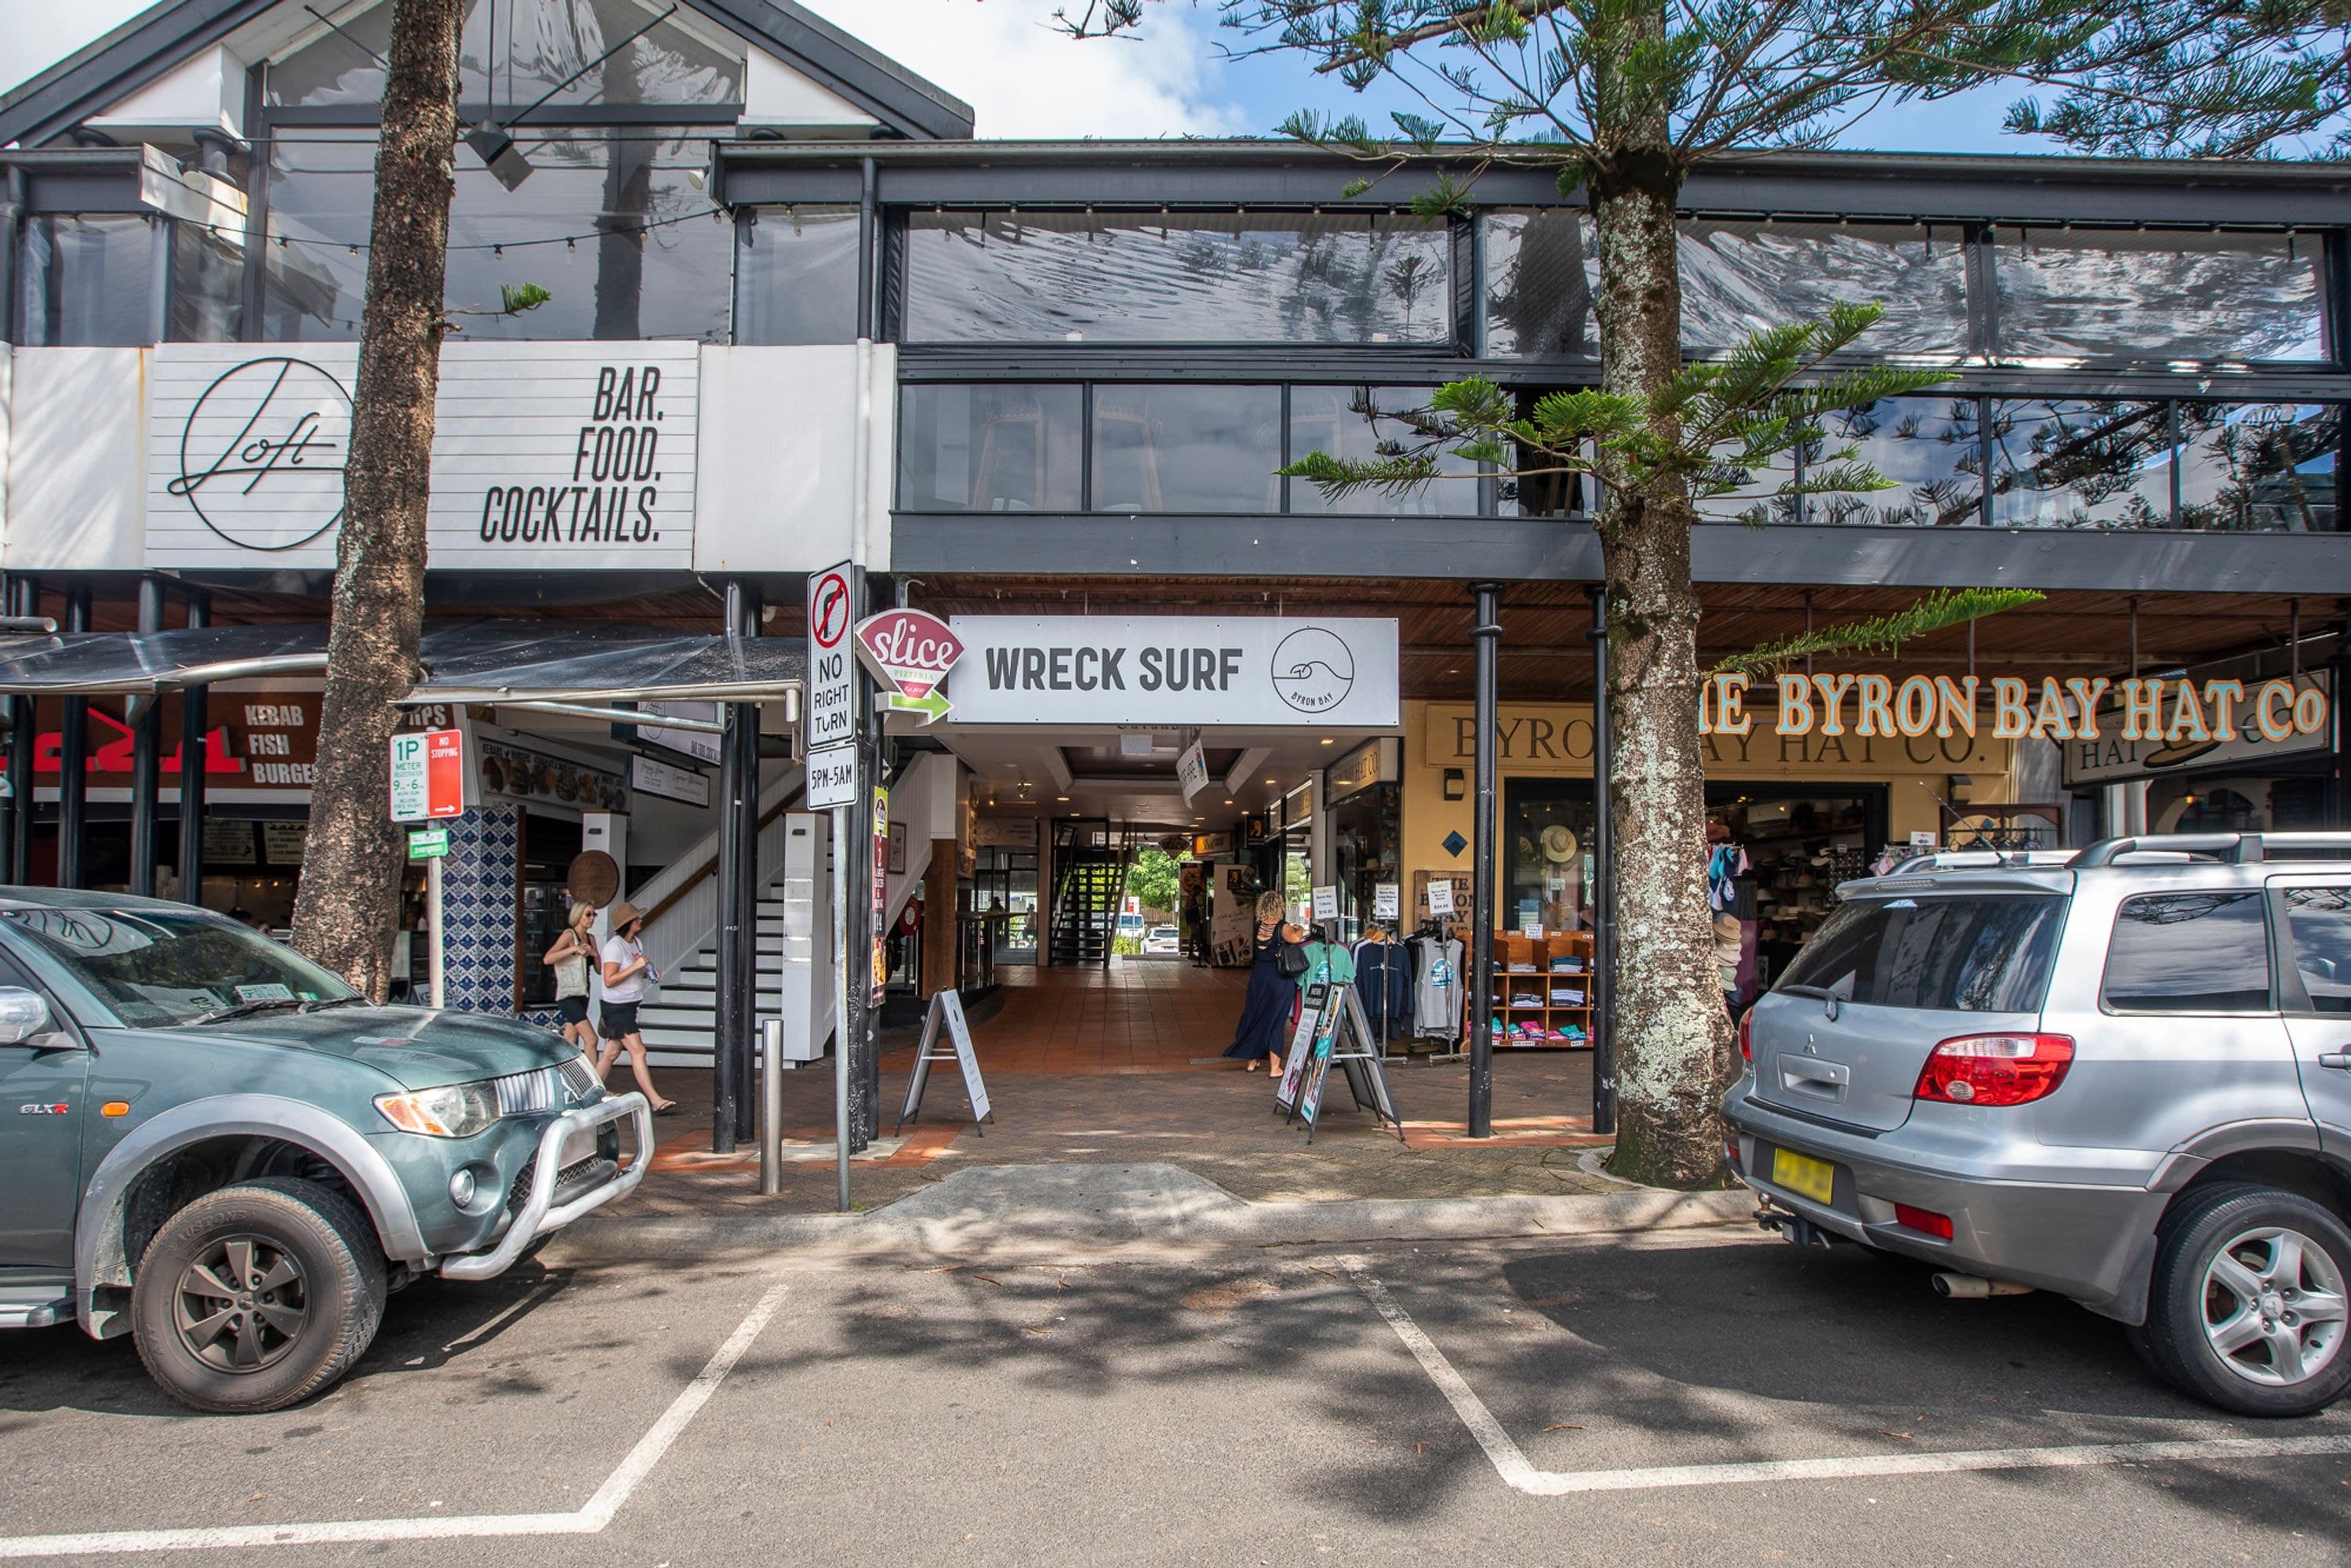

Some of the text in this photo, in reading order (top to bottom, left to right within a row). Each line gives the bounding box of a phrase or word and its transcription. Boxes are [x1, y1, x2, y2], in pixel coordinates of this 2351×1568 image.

[593, 367, 664, 421] BAR.
[574, 426, 661, 481] FOOD.
[480, 486, 660, 542] COCKTAILS.
[873, 618, 954, 670] slice
[819, 653, 843, 683] NO
[894, 670, 934, 681] PIZZERIA
[986, 647, 1243, 691] WRECK SURF
[815, 684, 848, 710] RIGHT
[1292, 692, 1333, 706] BYRON BAY
[1775, 673, 1980, 739] BYRON
[1991, 676, 2110, 740] BAY
[2121, 678, 2244, 742] HAT
[245, 706, 304, 726] KEBAB
[816, 709, 848, 734] TURN
[249, 734, 290, 755] FISH
[397, 739, 419, 760] 1P
[438, 736, 450, 746] NO
[1452, 717, 1595, 759] BYRO
[431, 747, 459, 759] STOPPING
[395, 762, 421, 771] METER
[812, 764, 852, 789] 5PM-5AM
